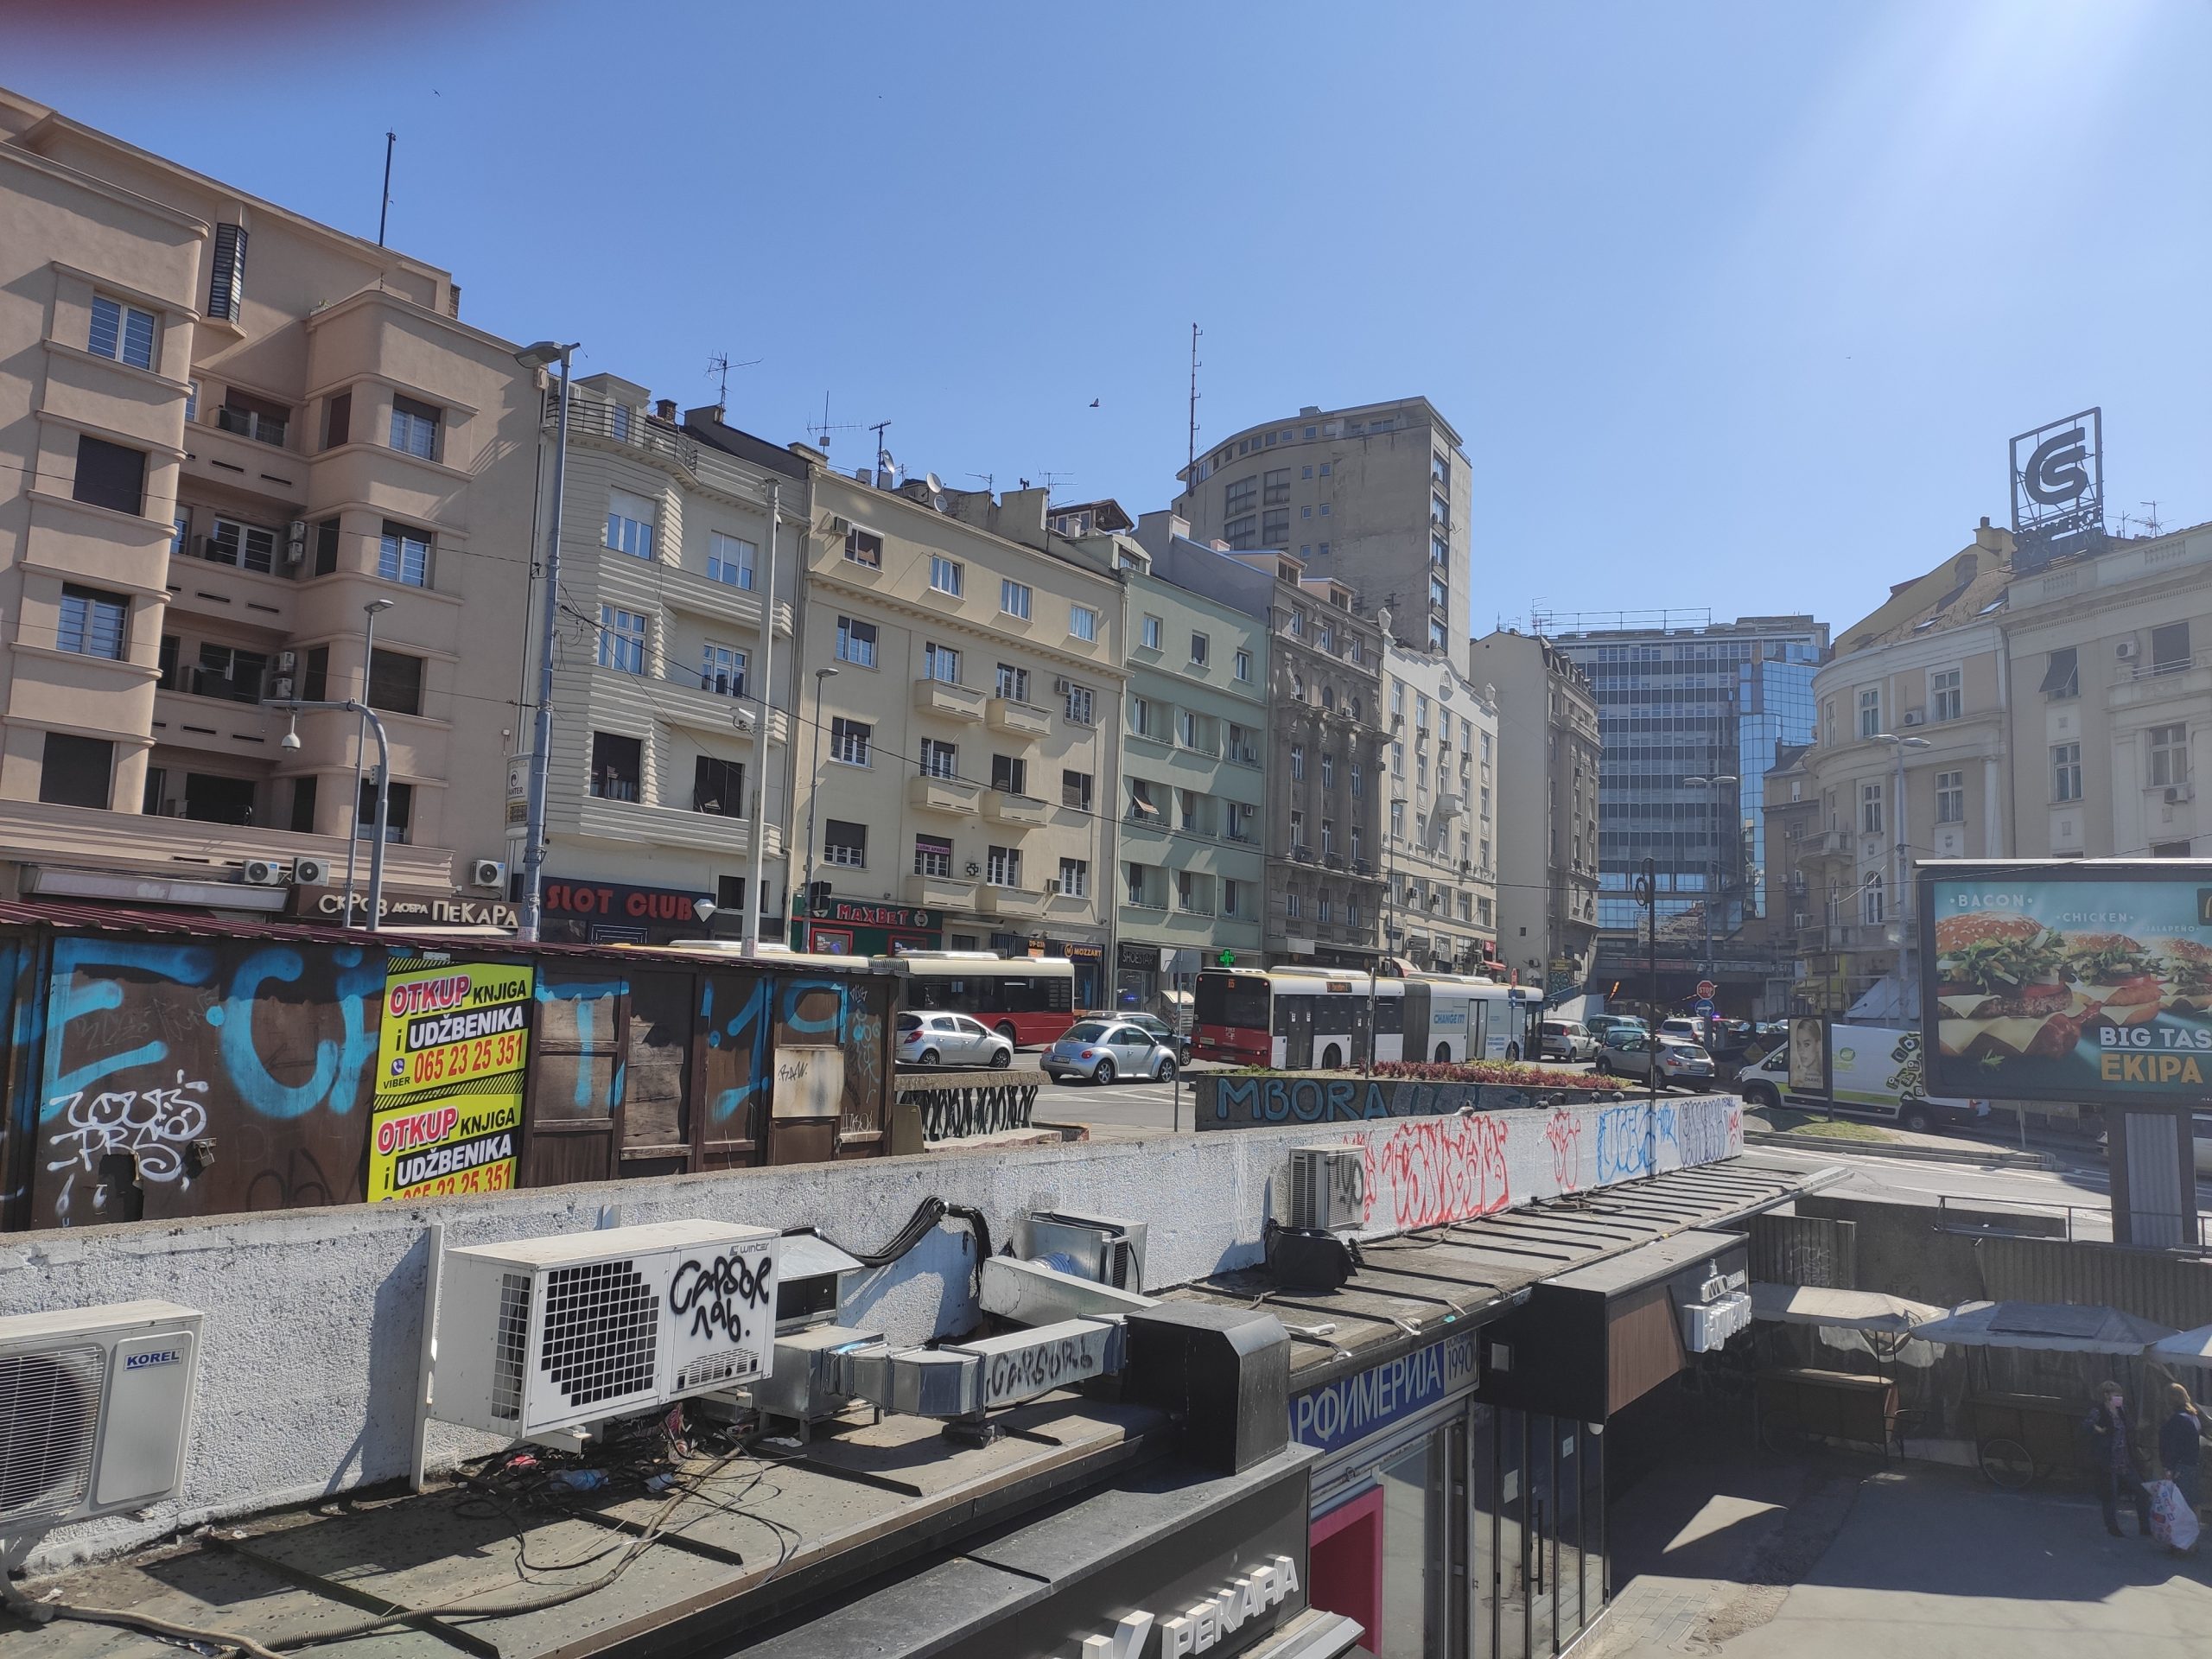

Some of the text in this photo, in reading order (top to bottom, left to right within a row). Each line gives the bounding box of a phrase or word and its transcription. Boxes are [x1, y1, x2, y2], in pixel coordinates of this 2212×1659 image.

[547, 886, 692, 920] SLOT CLUB
[1958, 894, 2024, 907] BACON
[2063, 912, 2127, 923] CHICKEN
[1074, 947, 1102, 957] MOZZART
[390, 975, 526, 1016] OTKUP KNJIGA
[410, 1006, 524, 1049] UDŽBENIKA
[1433, 1014, 1458, 1024] CHANGE
[2100, 1027, 2152, 1047] BIG
[414, 1032, 523, 1084] 065 23 25 351
[2101, 1053, 2204, 1084] EKIPA
[383, 1077, 410, 1090] VIBER
[377, 1106, 515, 1154] OTKUP KNJIGA
[397, 1134, 512, 1186] UDŽBENIKA
[483, 1161, 512, 1192] 351
[127, 1351, 180, 1366] KOREL
[1447, 1343, 1473, 1382] 1990
[1161, 1555, 1300, 1659] PEKARA
